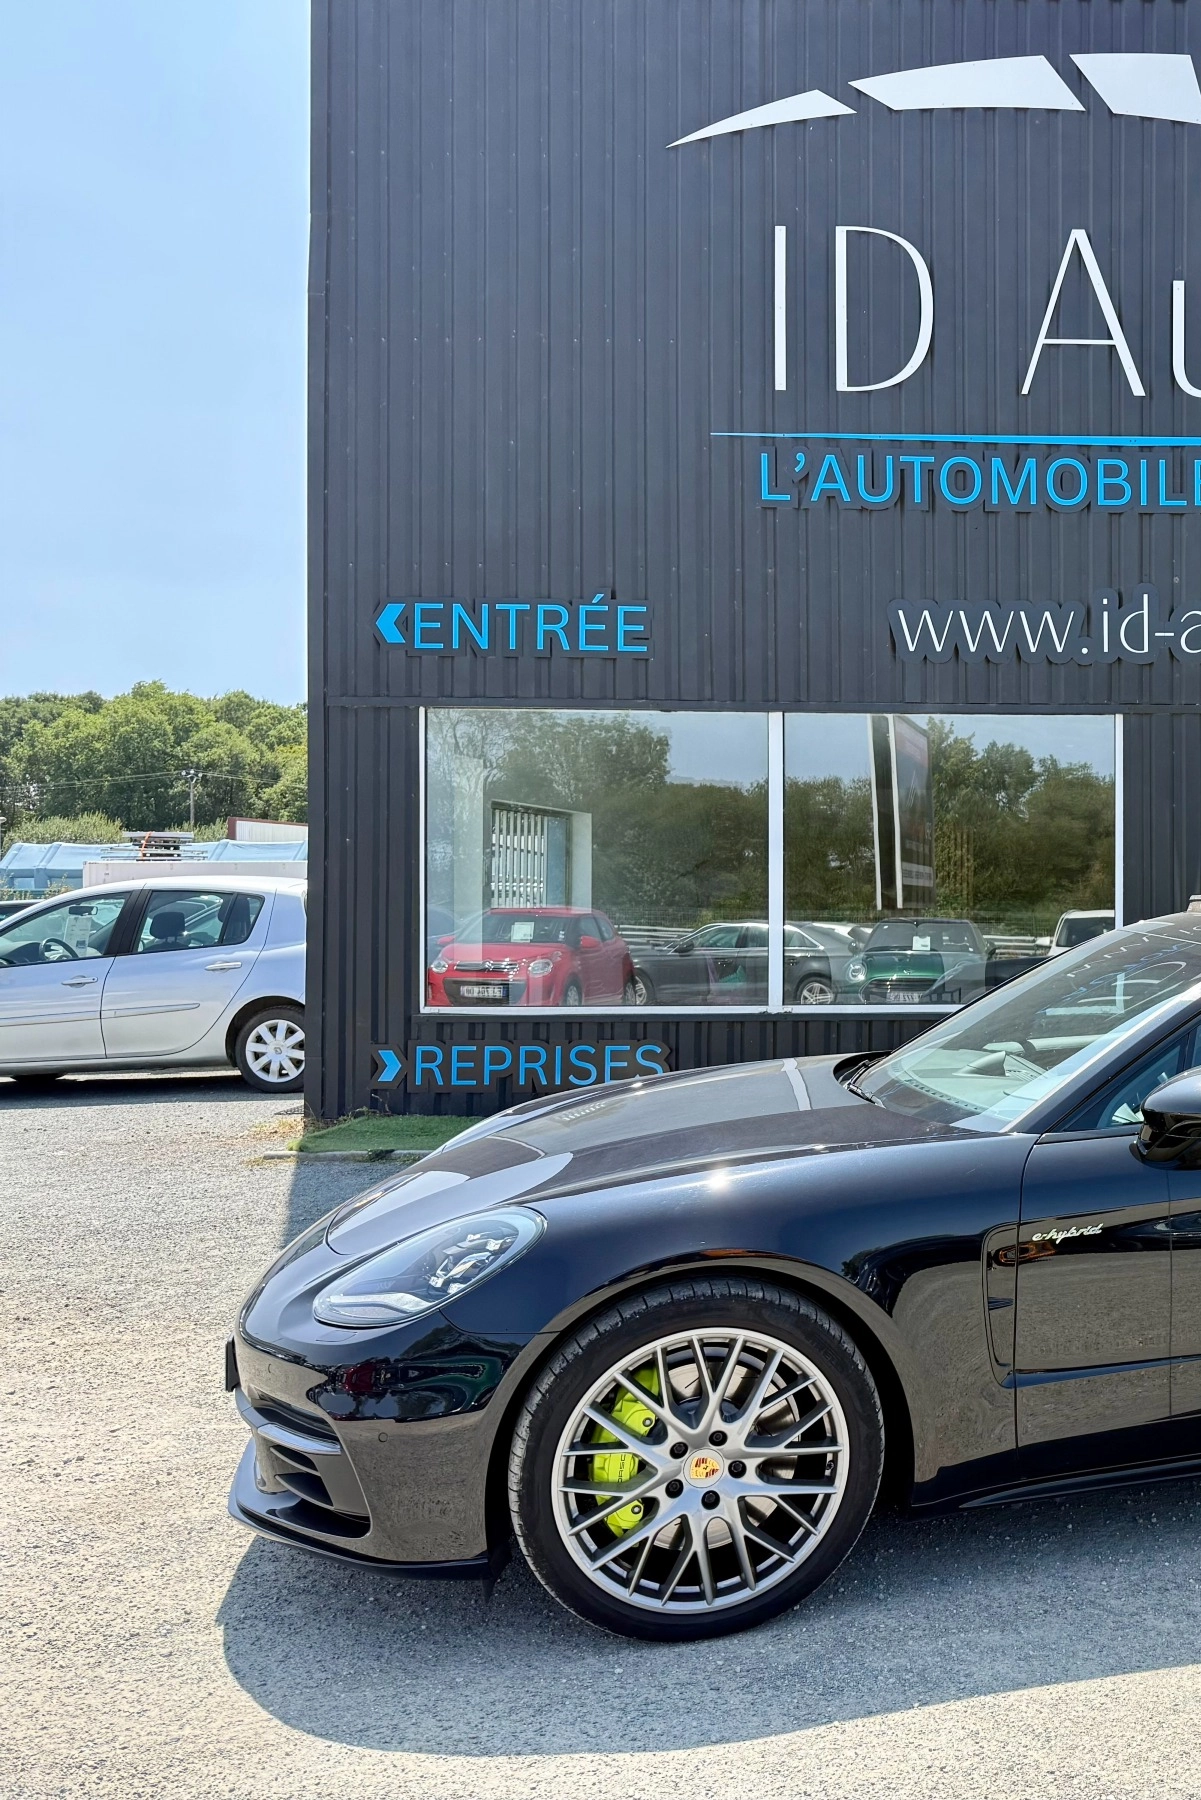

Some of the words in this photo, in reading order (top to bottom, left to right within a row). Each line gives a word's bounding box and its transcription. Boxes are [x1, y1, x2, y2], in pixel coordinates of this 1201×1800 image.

[774, 225, 934, 392] ID
[413, 592, 648, 653] ENTRÉE
[414, 1045, 663, 1086] REPRISES
[1031, 1222, 1104, 1245] e-hybrid
